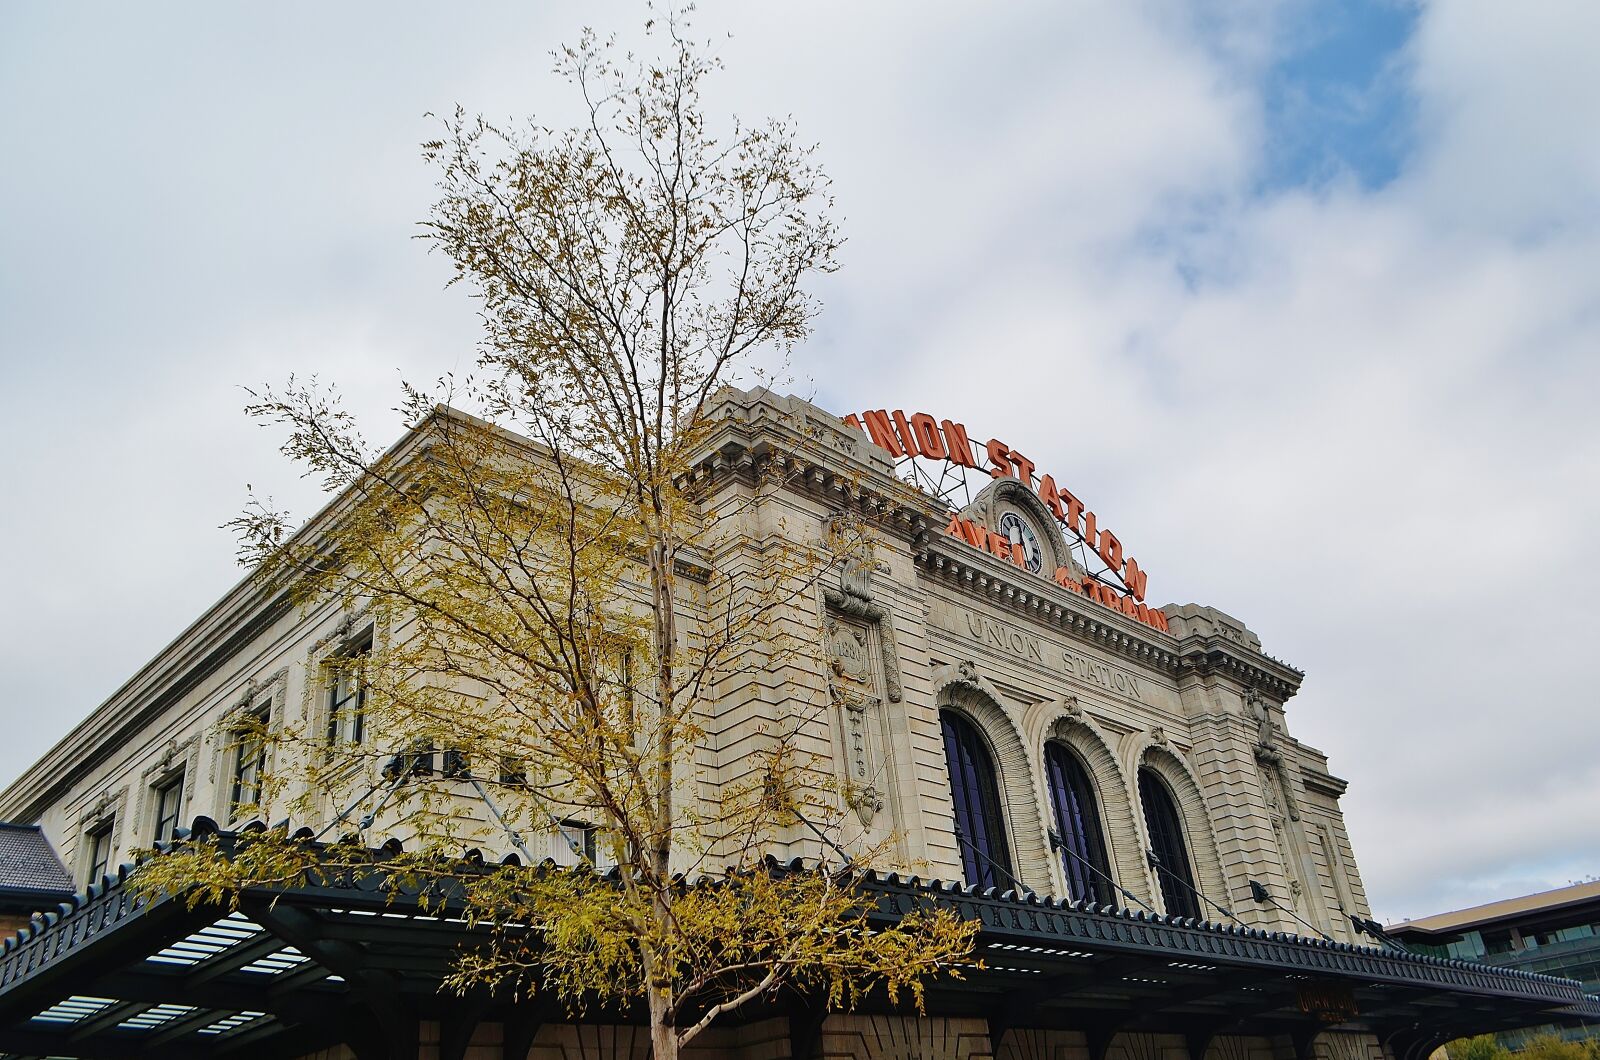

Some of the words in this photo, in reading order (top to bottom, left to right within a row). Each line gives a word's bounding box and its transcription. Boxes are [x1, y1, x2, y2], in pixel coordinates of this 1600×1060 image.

[844, 409, 977, 469] NION
[986, 438, 1148, 602] STATION
[965, 613, 1043, 662] UNION
[1061, 651, 1141, 699] STATION
